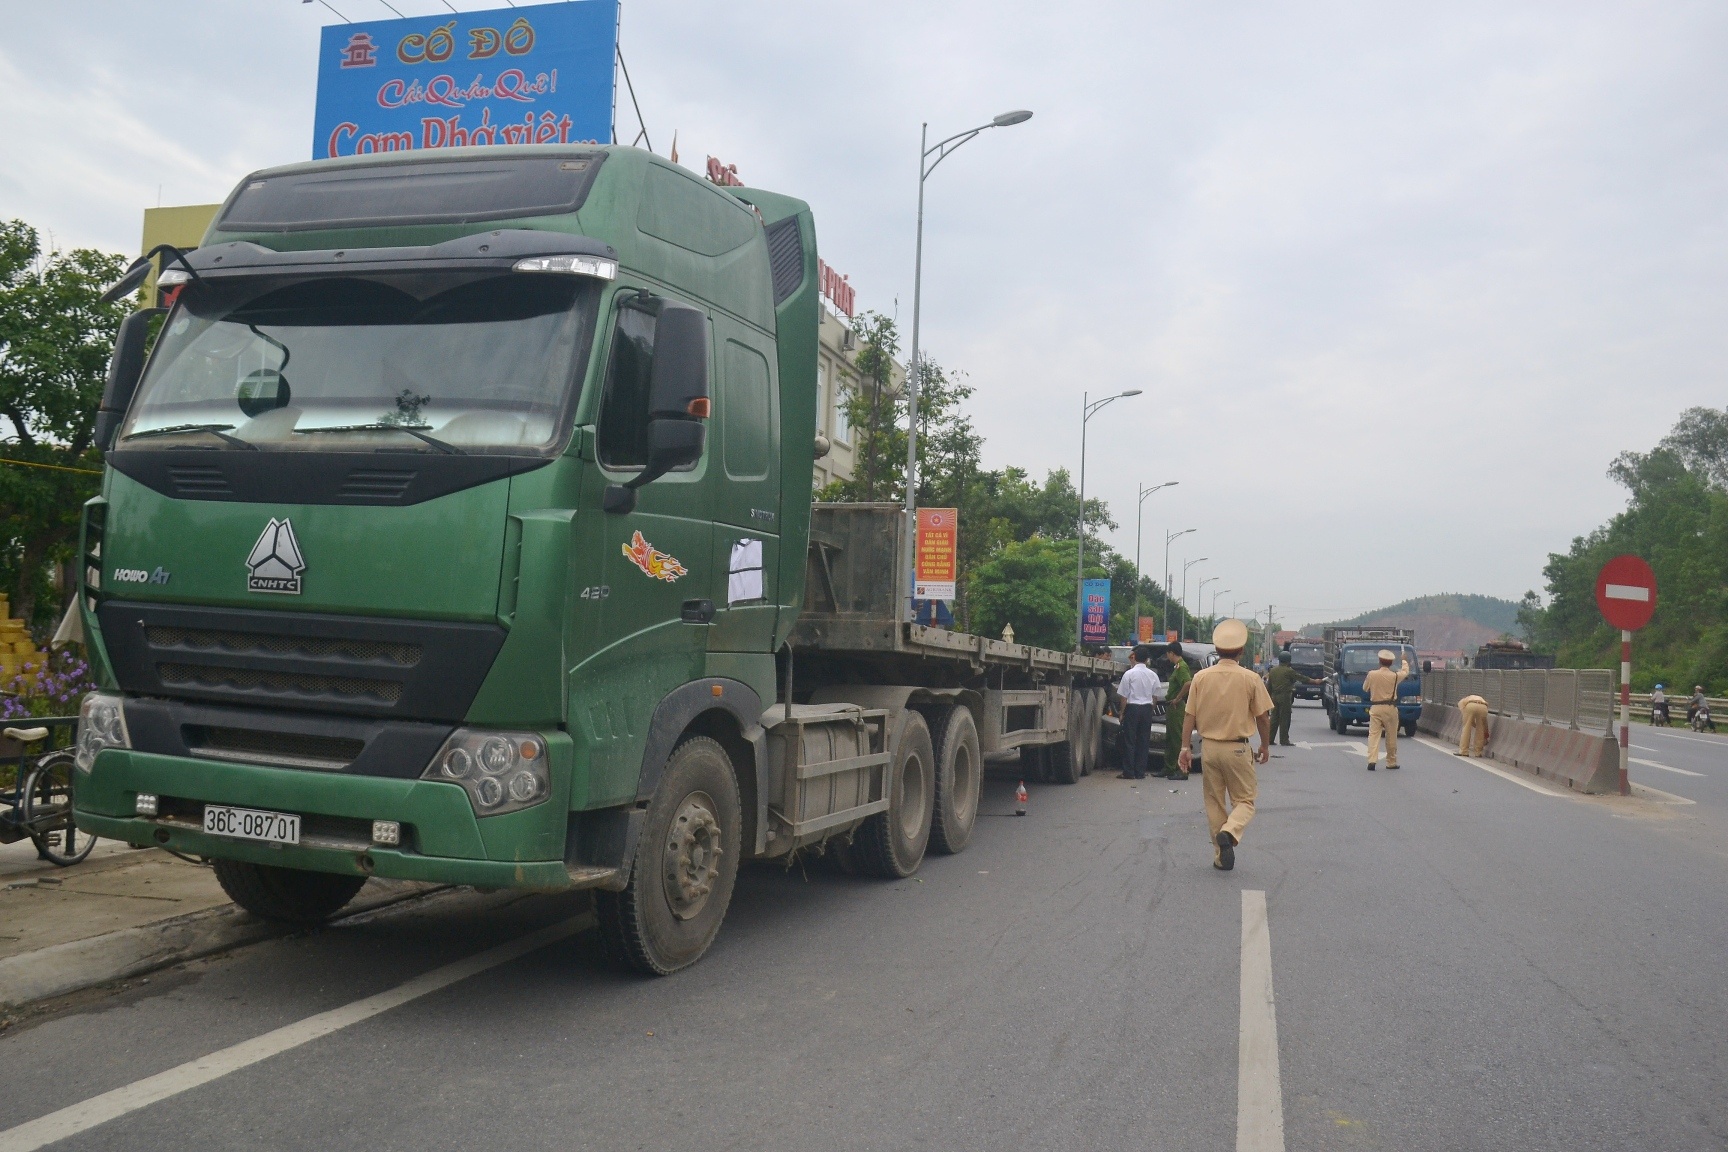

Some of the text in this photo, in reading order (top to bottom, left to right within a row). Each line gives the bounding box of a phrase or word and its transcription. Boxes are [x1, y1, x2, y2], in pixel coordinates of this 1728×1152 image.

[396, 17, 536, 64] CỐ ĐÔ
[328, 121, 414, 159] Cơm
[113, 566, 171, 584] HOWO A7
[250, 578, 298, 590] CNHTC
